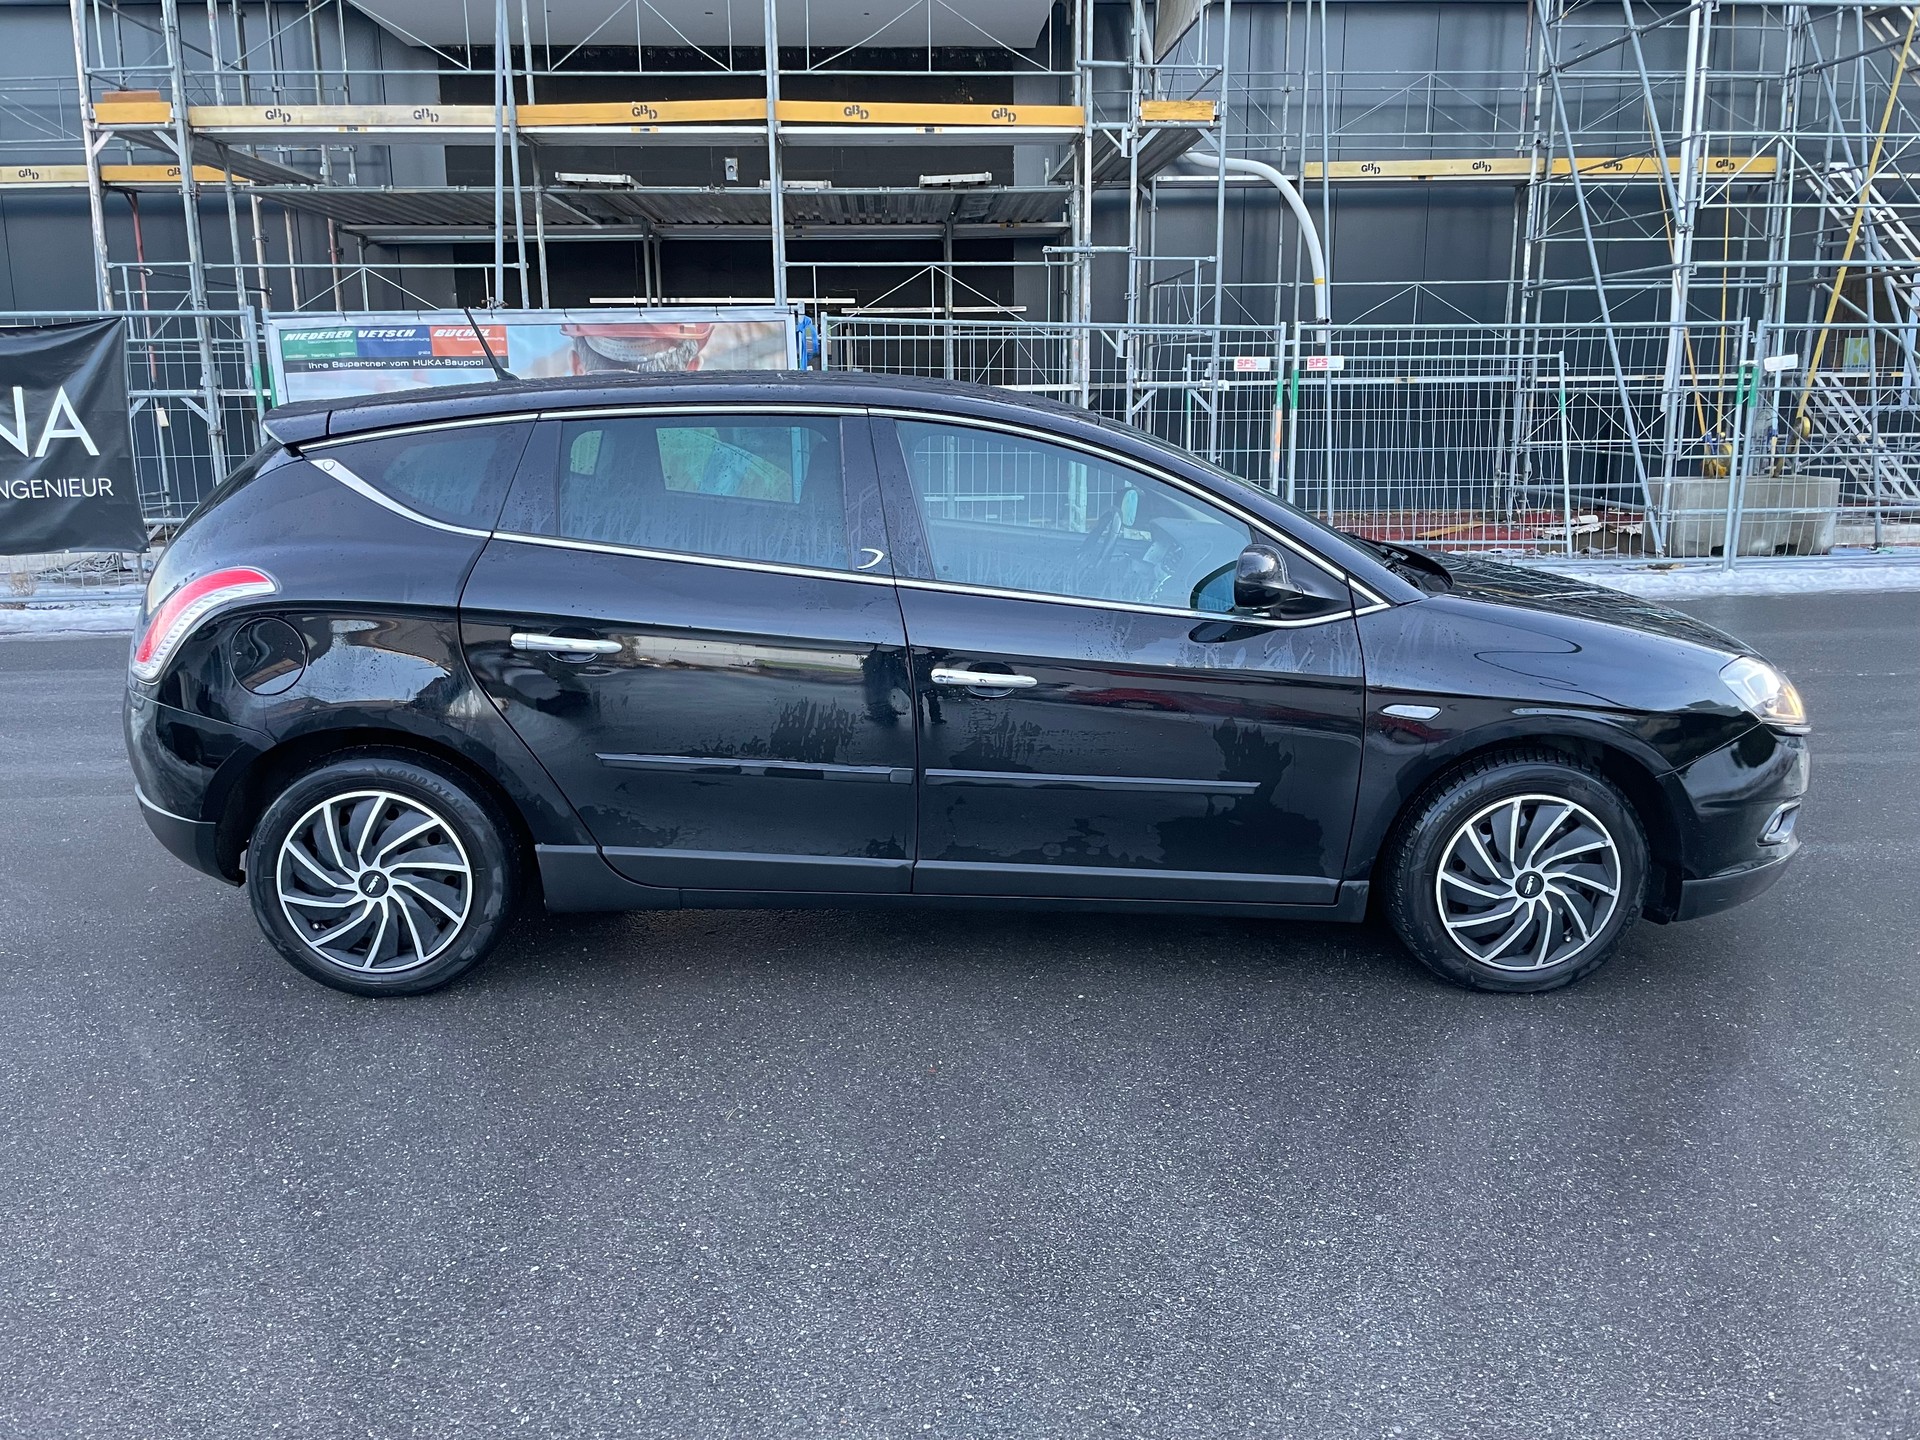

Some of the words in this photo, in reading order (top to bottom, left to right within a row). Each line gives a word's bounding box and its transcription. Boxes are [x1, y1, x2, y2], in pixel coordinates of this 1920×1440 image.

[283, 330, 353, 341] NIEDERER
[357, 329, 417, 338] VETSCH
[1237, 359, 1257, 367] SFS
[1308, 358, 1328, 367] SFS
